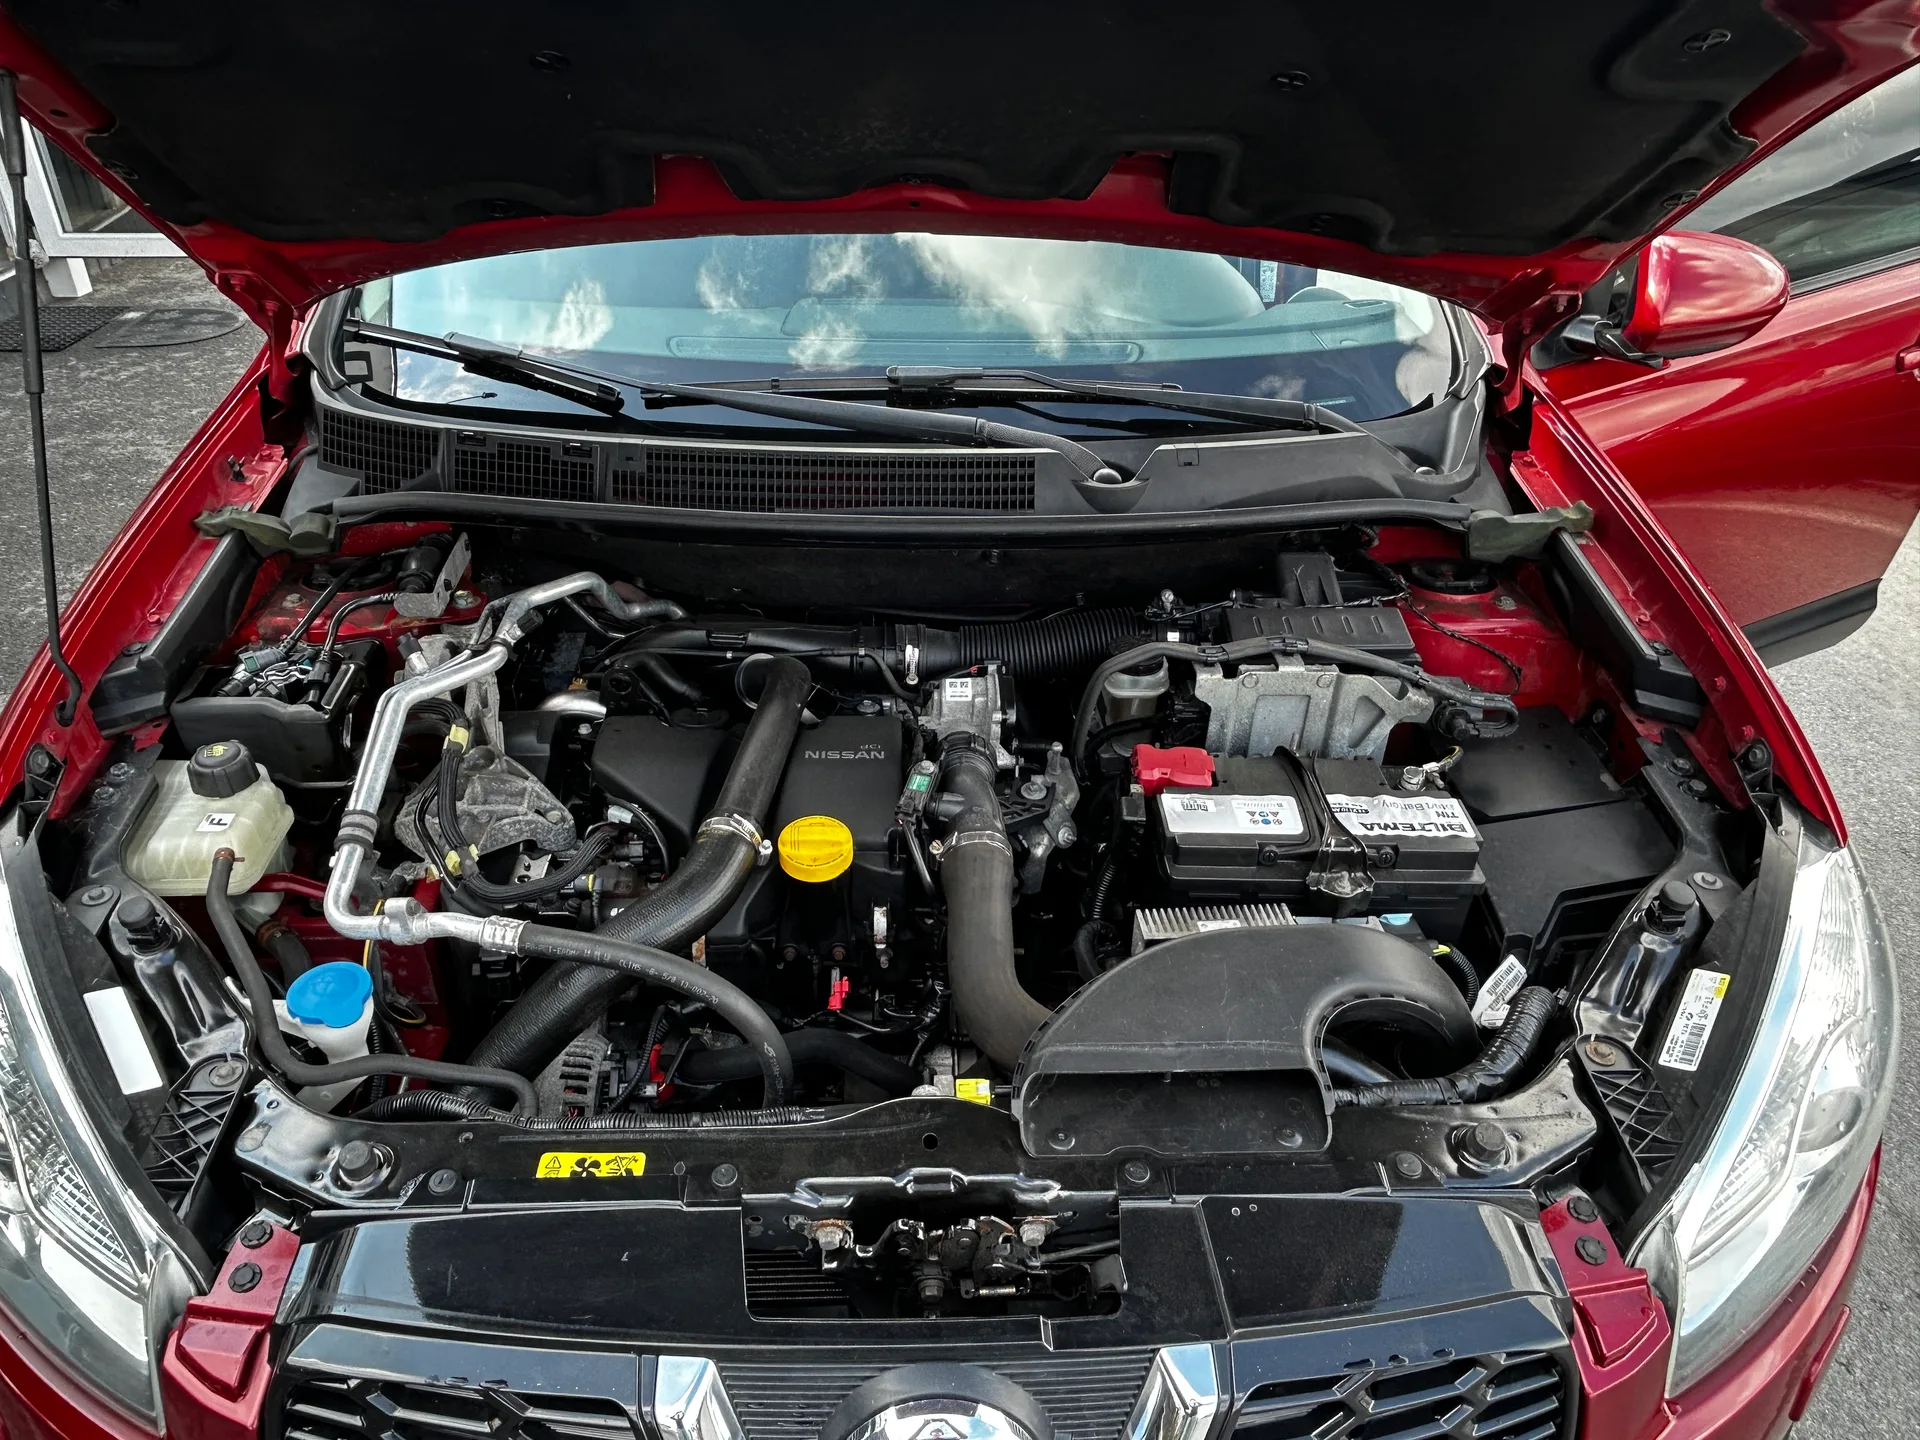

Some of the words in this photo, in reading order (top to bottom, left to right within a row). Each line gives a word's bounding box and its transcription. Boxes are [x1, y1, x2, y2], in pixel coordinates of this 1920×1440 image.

[804, 750, 885, 759] NISSAN
[208, 817, 228, 826] F
[1358, 822, 1468, 833] BILTEMA
